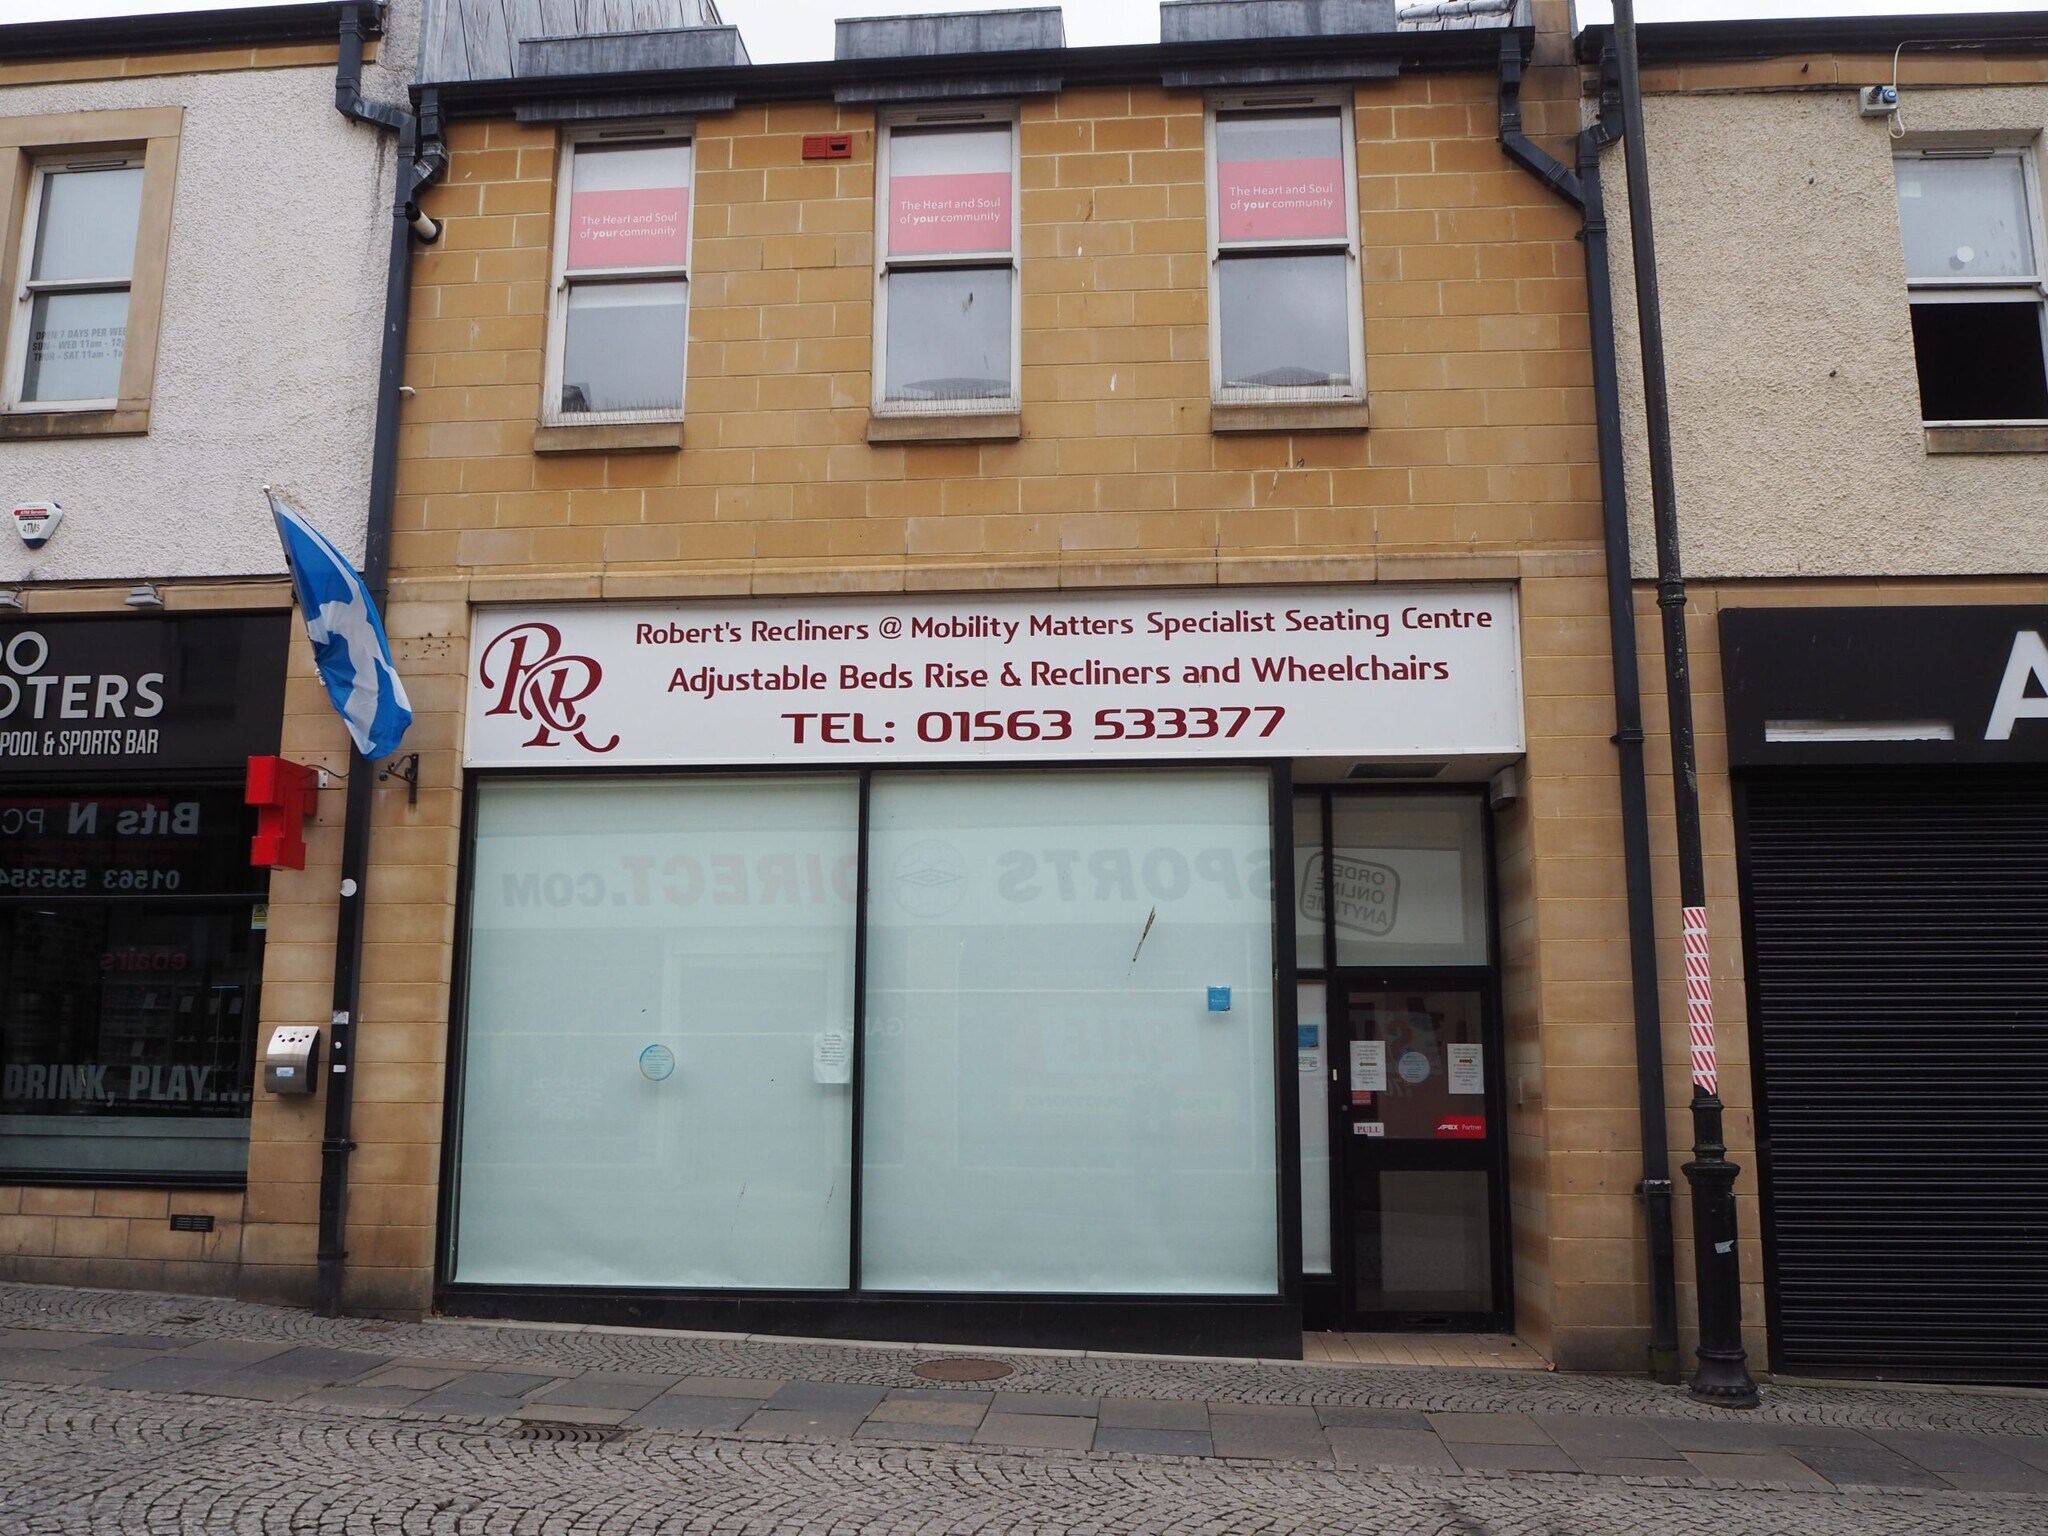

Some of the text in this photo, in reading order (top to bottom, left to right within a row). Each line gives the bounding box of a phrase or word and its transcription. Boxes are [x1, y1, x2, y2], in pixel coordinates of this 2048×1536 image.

[1229, 183, 1333, 197] The Heart and Soul
[900, 197, 1001, 211] The Heart and Soul
[1230, 198, 1333, 212] of your community
[581, 211, 677, 225] The Heart and Soul
[899, 211, 1001, 226] of your community
[580, 226, 677, 240] of your community
[68, 328, 89, 339] DAYS
[635, 607, 1493, 645] Robert's Recliners @ Mobility Matters Specialist Seating Centre
[667, 654, 1450, 699] Adjustable Beds Rise & Recliners and Wheelchairs
[780, 706, 1287, 744] TEL: 01563 533377
[0, 728, 160, 756] POOL & SPORTS BAR
[3, 1063, 116, 1108] DRINK,
[1357, 1126, 1381, 1134] PULL
